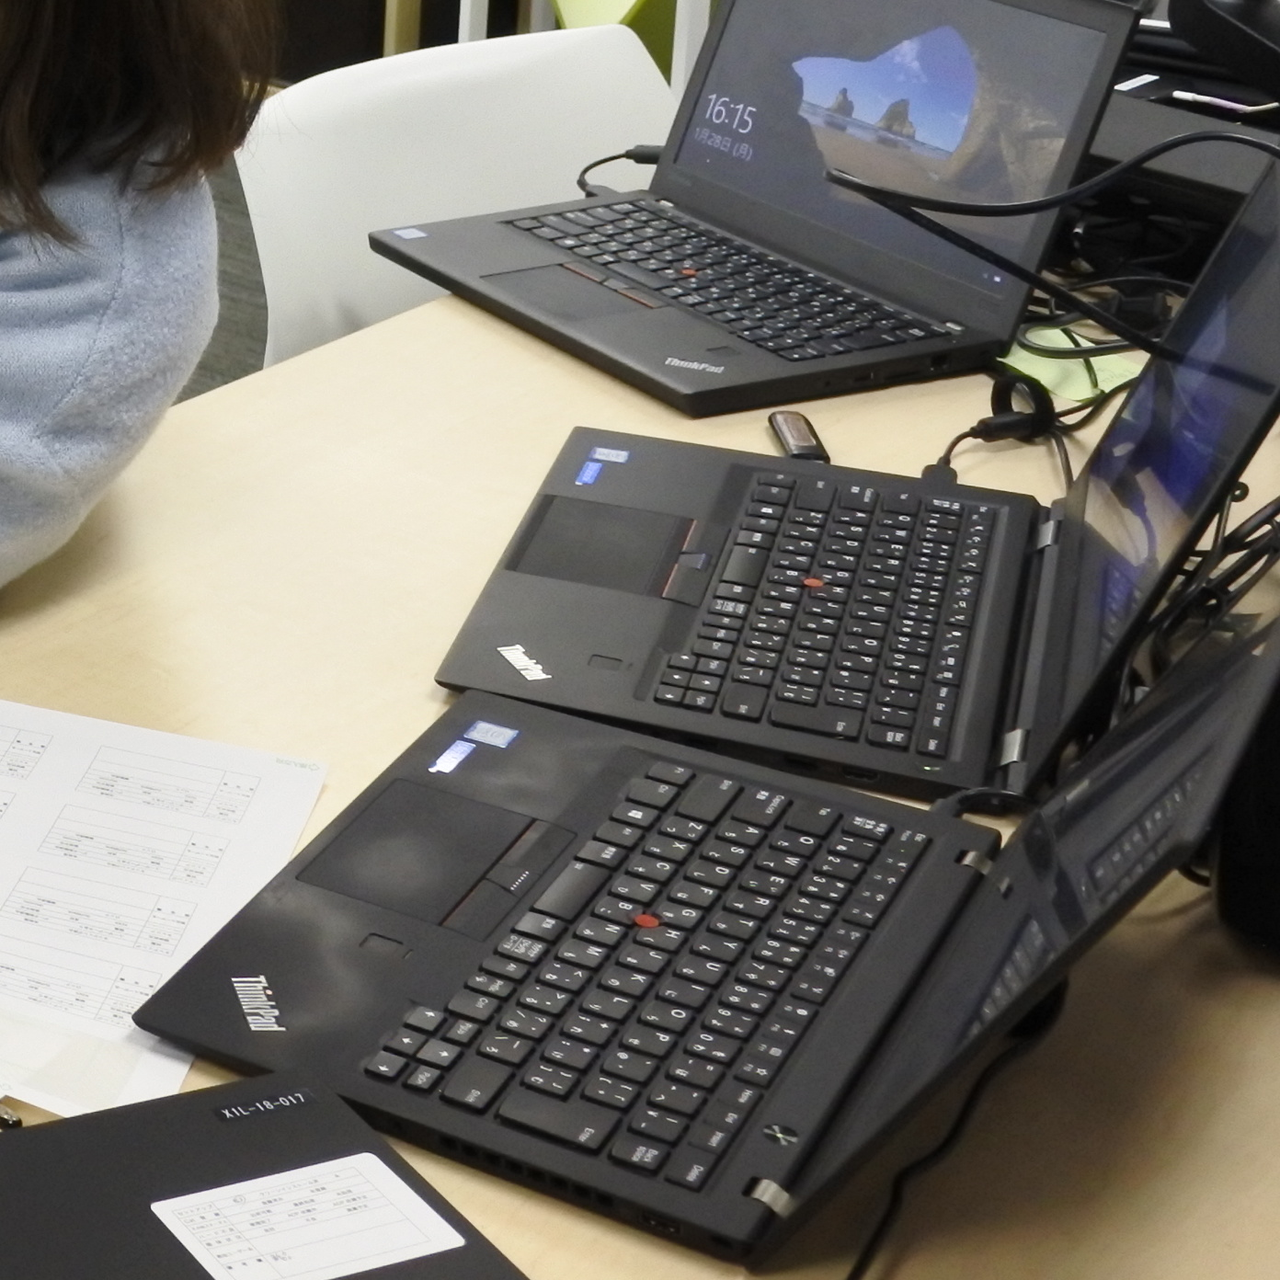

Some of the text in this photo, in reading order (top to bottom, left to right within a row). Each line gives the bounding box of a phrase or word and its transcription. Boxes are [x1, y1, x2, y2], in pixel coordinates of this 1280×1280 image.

[704, 92, 757, 136] 16:15
[665, 355, 726, 375] ThinkPad
[688, 822, 703, 831] Z
[745, 826, 760, 835] A
[672, 841, 687, 850] X
[730, 846, 745, 854] S
[784, 856, 801, 867] W
[656, 862, 671, 871] C
[715, 867, 730, 875] D
[770, 876, 785, 885] E
[812, 876, 826, 884] 3
[640, 883, 655, 891] V
[700, 886, 714, 896] F
[754, 896, 770, 906] R
[798, 897, 811, 905] 4
[618, 901, 633, 911] B
[681, 909, 697, 918] G
[739, 919, 754, 928] T
[783, 918, 797, 927] 5
[604, 924, 621, 934] N
[665, 929, 681, 939] H
[723, 941, 738, 950] Y
[767, 940, 781, 948] 6
[586, 945, 603, 957] M
[649, 951, 663, 960] J
[705, 962, 722, 971] U
[752, 962, 766, 970] 7
[630, 973, 647, 984] K
[734, 985, 749, 993] 8
[475, 997, 489, 1009] Ctrl
[670, 1009, 686, 1018] O
[717, 1008, 732, 1017] 9
[655, 1032, 670, 1042] P
[699, 1033, 714, 1041] 0
[220, 1093, 306, 1120] X1L-18-017
[724, 1112, 739, 1124] End
